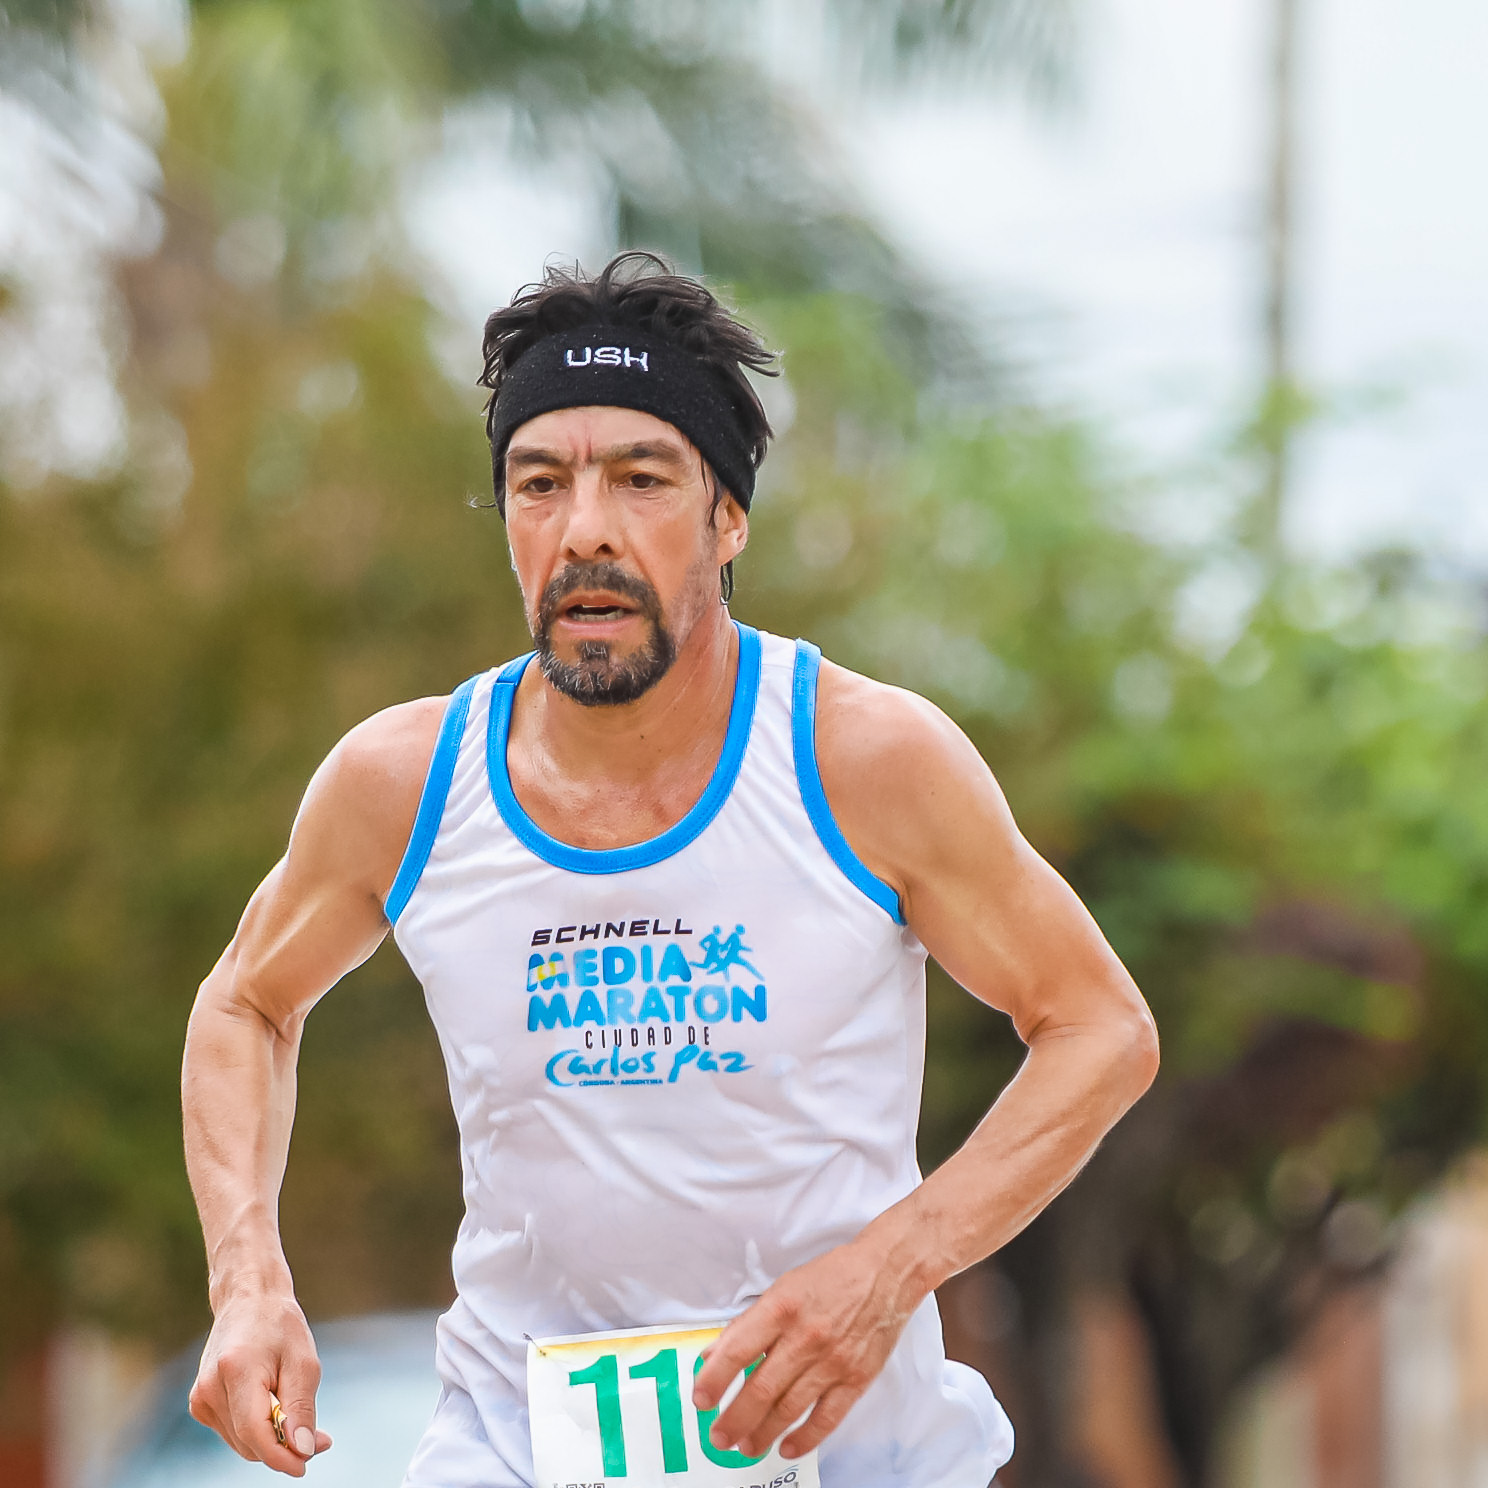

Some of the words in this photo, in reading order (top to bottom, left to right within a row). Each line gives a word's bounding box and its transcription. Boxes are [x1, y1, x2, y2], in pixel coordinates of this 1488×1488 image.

[530, 918, 694, 947] SCHNELL
[526, 943, 693, 993] MEDIA
[526, 984, 768, 1032] MARATON
[584, 1026, 673, 1050] CIUDAD
[687, 1025, 710, 1046] DE
[545, 1045, 657, 1087] Carlos
[667, 1044, 755, 1083] Paz
